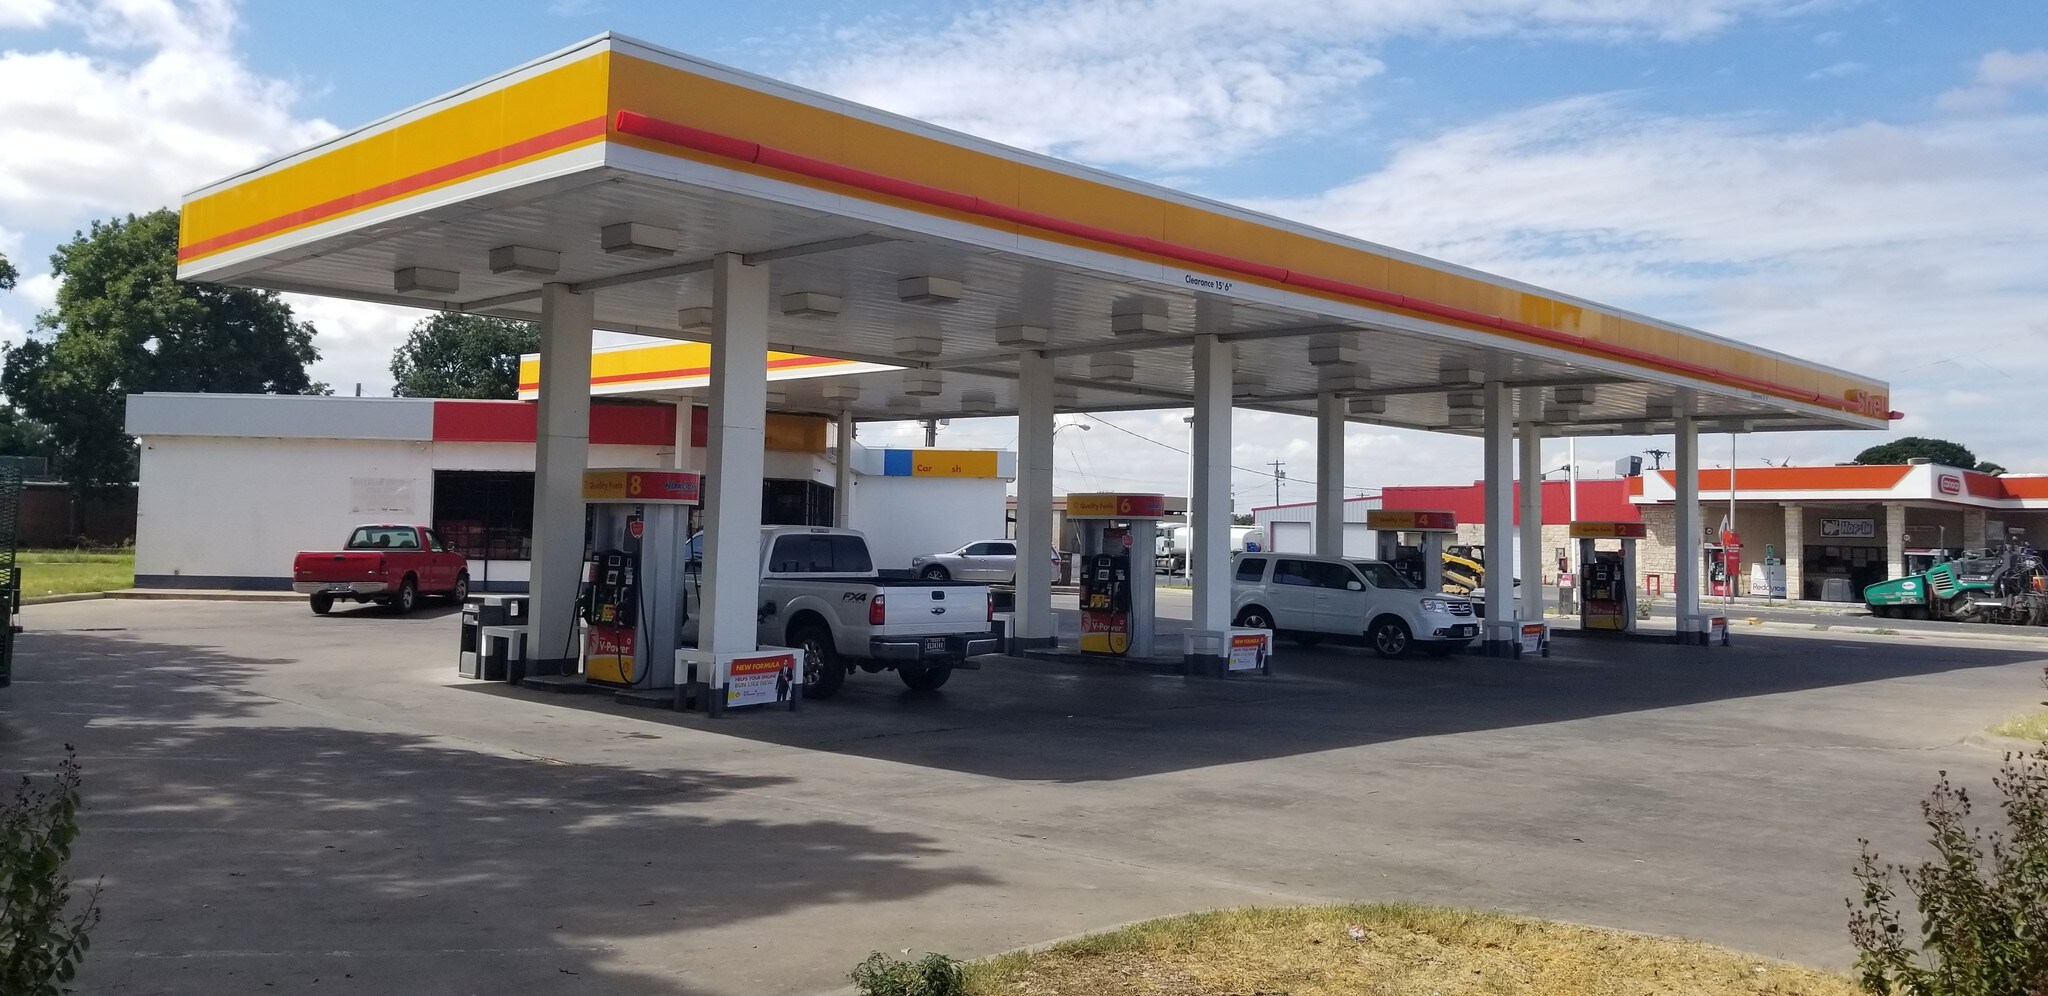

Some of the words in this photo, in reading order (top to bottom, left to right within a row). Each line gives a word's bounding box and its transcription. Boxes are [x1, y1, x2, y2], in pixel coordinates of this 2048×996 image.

[1184, 274, 1214, 288] Clearance
[917, 464, 932, 472] Car
[589, 481, 607, 490] Quality
[630, 475, 641, 495] 8
[1080, 502, 1099, 510] Quality
[1120, 499, 1131, 512] 6
[1419, 514, 1428, 526] 4
[1619, 525, 1626, 535] 2
[843, 592, 867, 601] FX4
[752, 661, 780, 669] FORMULA
